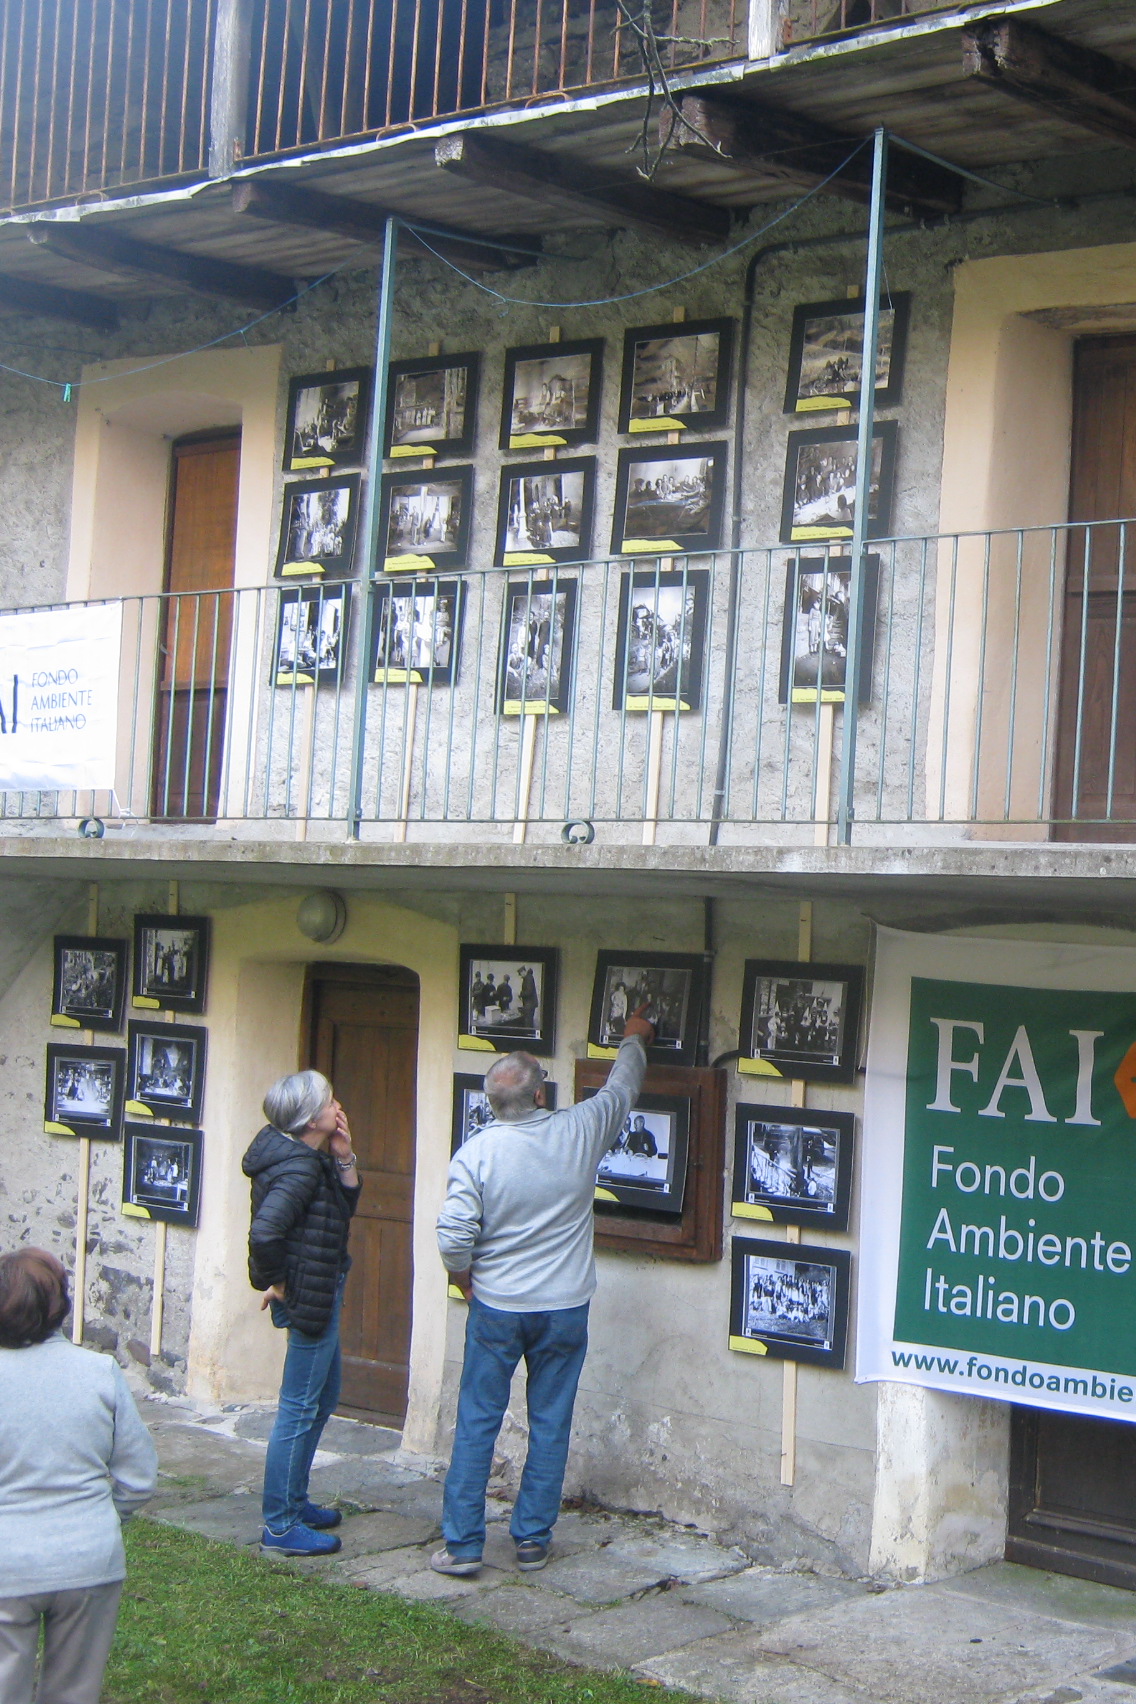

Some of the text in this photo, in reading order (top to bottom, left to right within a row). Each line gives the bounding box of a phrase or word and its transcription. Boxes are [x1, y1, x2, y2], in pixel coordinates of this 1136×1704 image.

[30, 689, 93, 710] AMBIENTE
[31, 668, 78, 688] FONDO
[30, 713, 86, 733] ITALIANO
[925, 1016, 1105, 1127] FAI
[930, 1144, 1066, 1203] Fondo
[926, 1207, 1133, 1274] Ambiente
[923, 1266, 1077, 1331] Italiano
